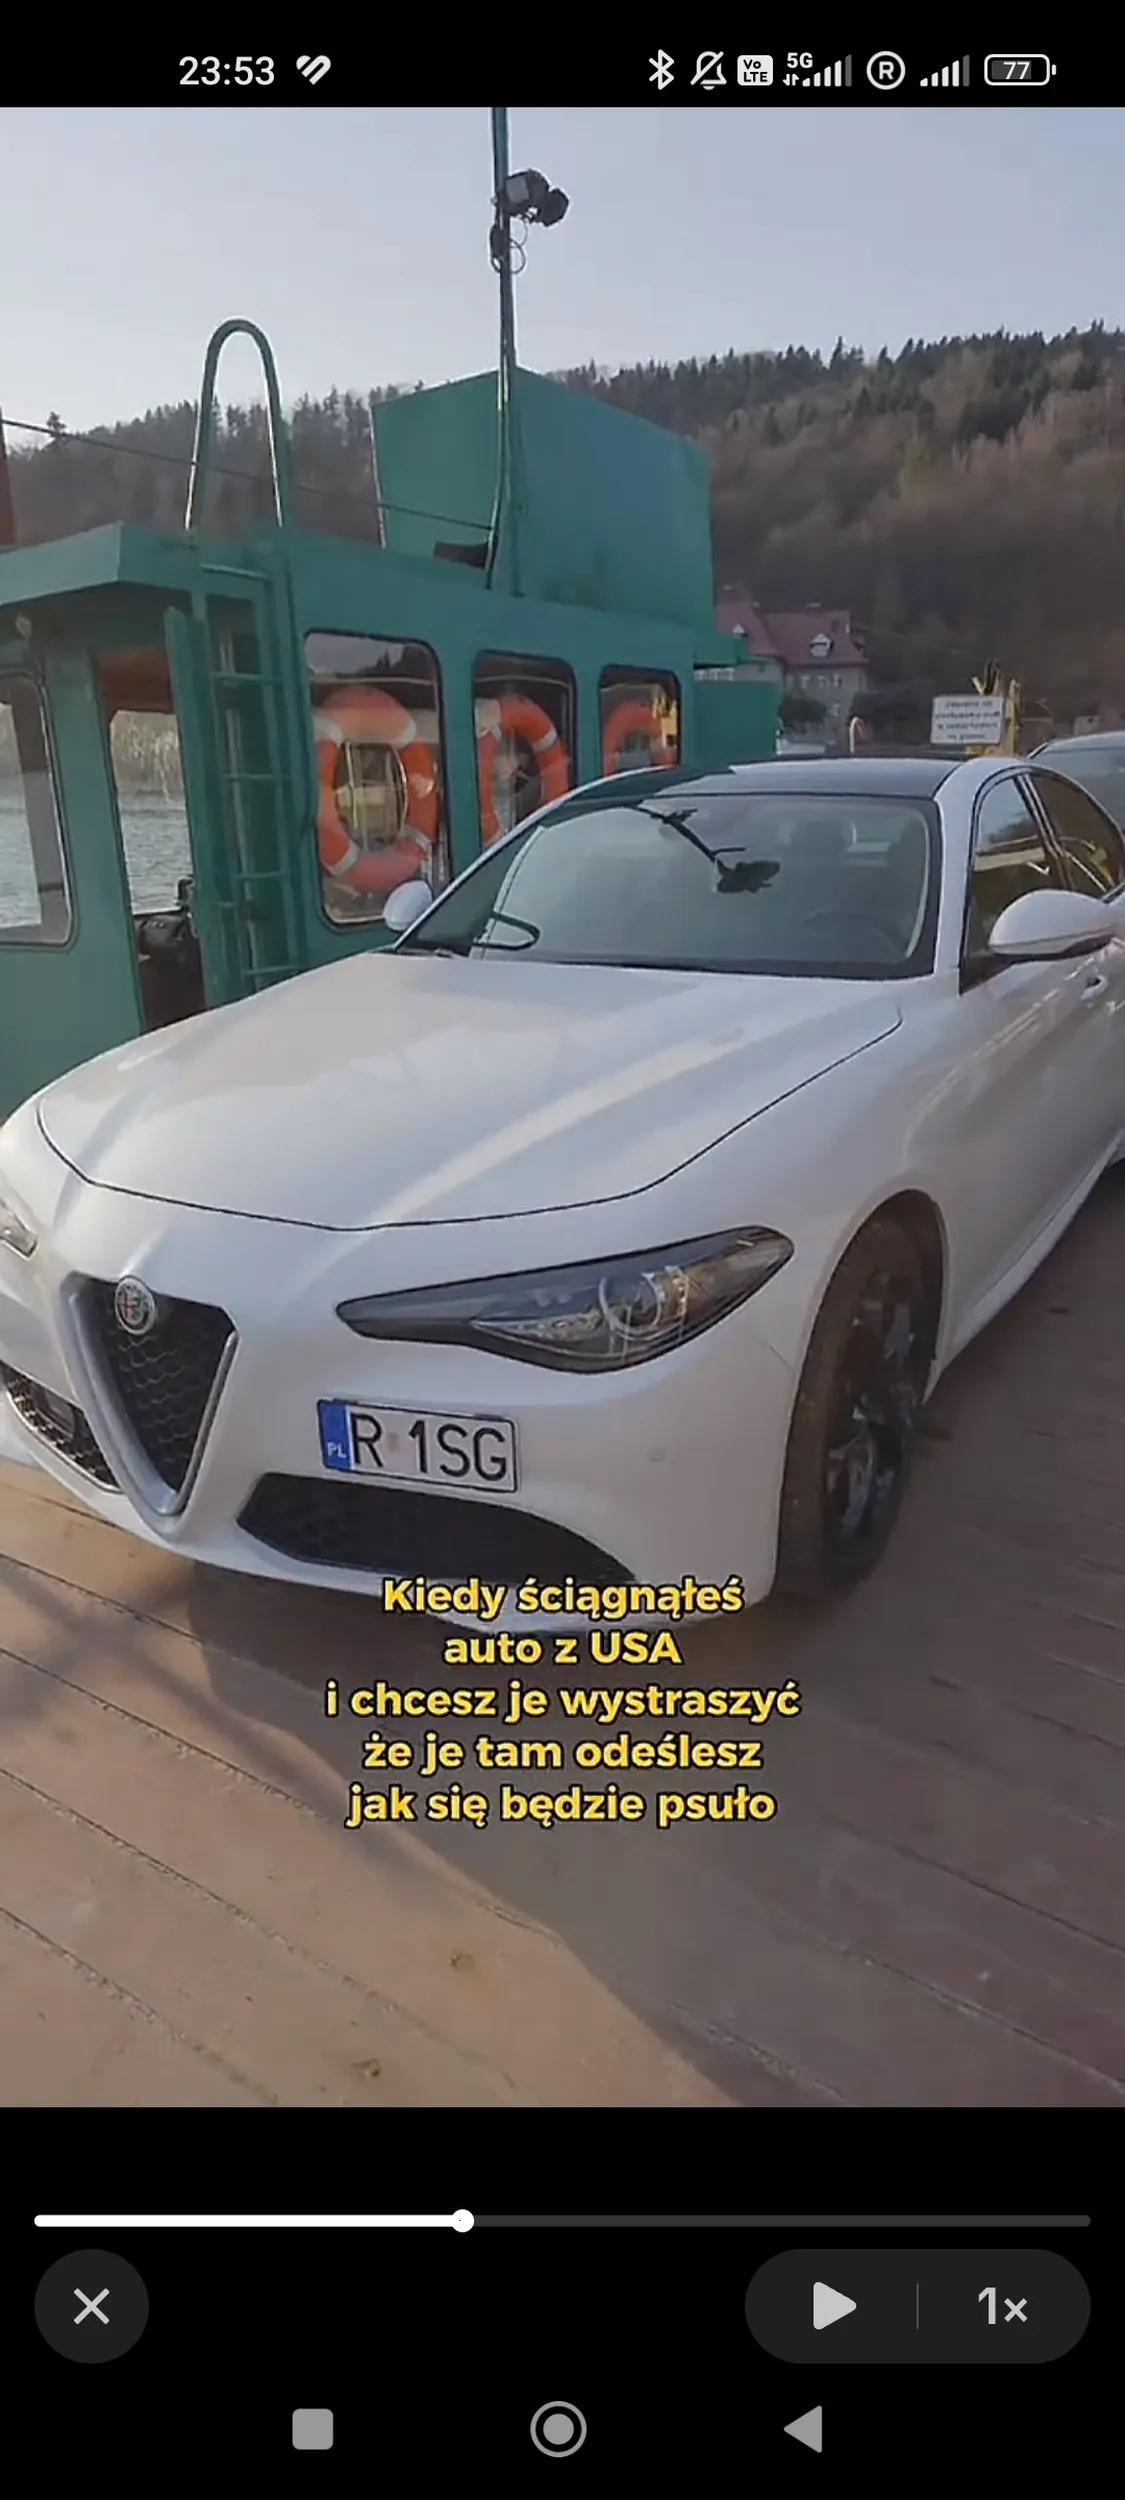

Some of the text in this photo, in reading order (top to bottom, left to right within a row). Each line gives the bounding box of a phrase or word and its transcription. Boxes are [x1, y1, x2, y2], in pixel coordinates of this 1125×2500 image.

[327, 1442, 346, 1458] PL
[351, 1413, 507, 1481] R 1SG
